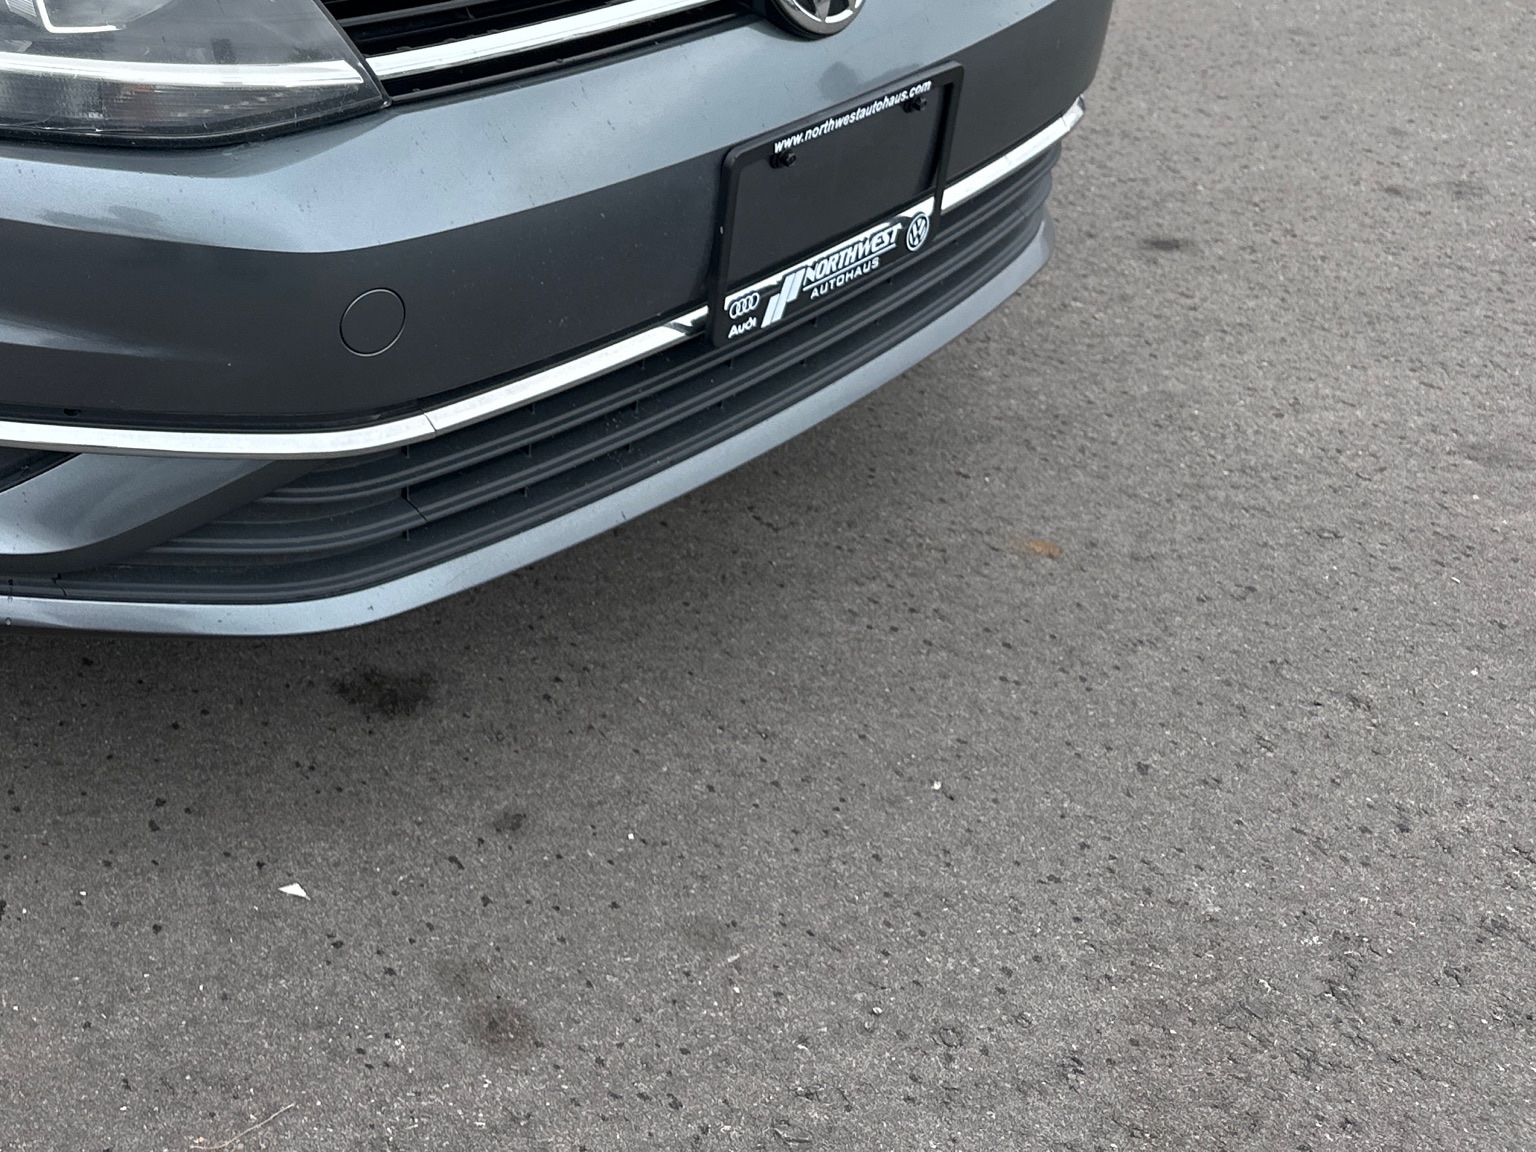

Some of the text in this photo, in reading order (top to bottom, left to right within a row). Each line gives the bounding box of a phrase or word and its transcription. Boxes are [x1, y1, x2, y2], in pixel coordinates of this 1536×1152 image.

[773, 79, 933, 154] www.northwestautohaus.com
[802, 222, 904, 286] NORTHWEST
[810, 256, 881, 300] AUTOHAUS
[727, 316, 758, 339] Audi
